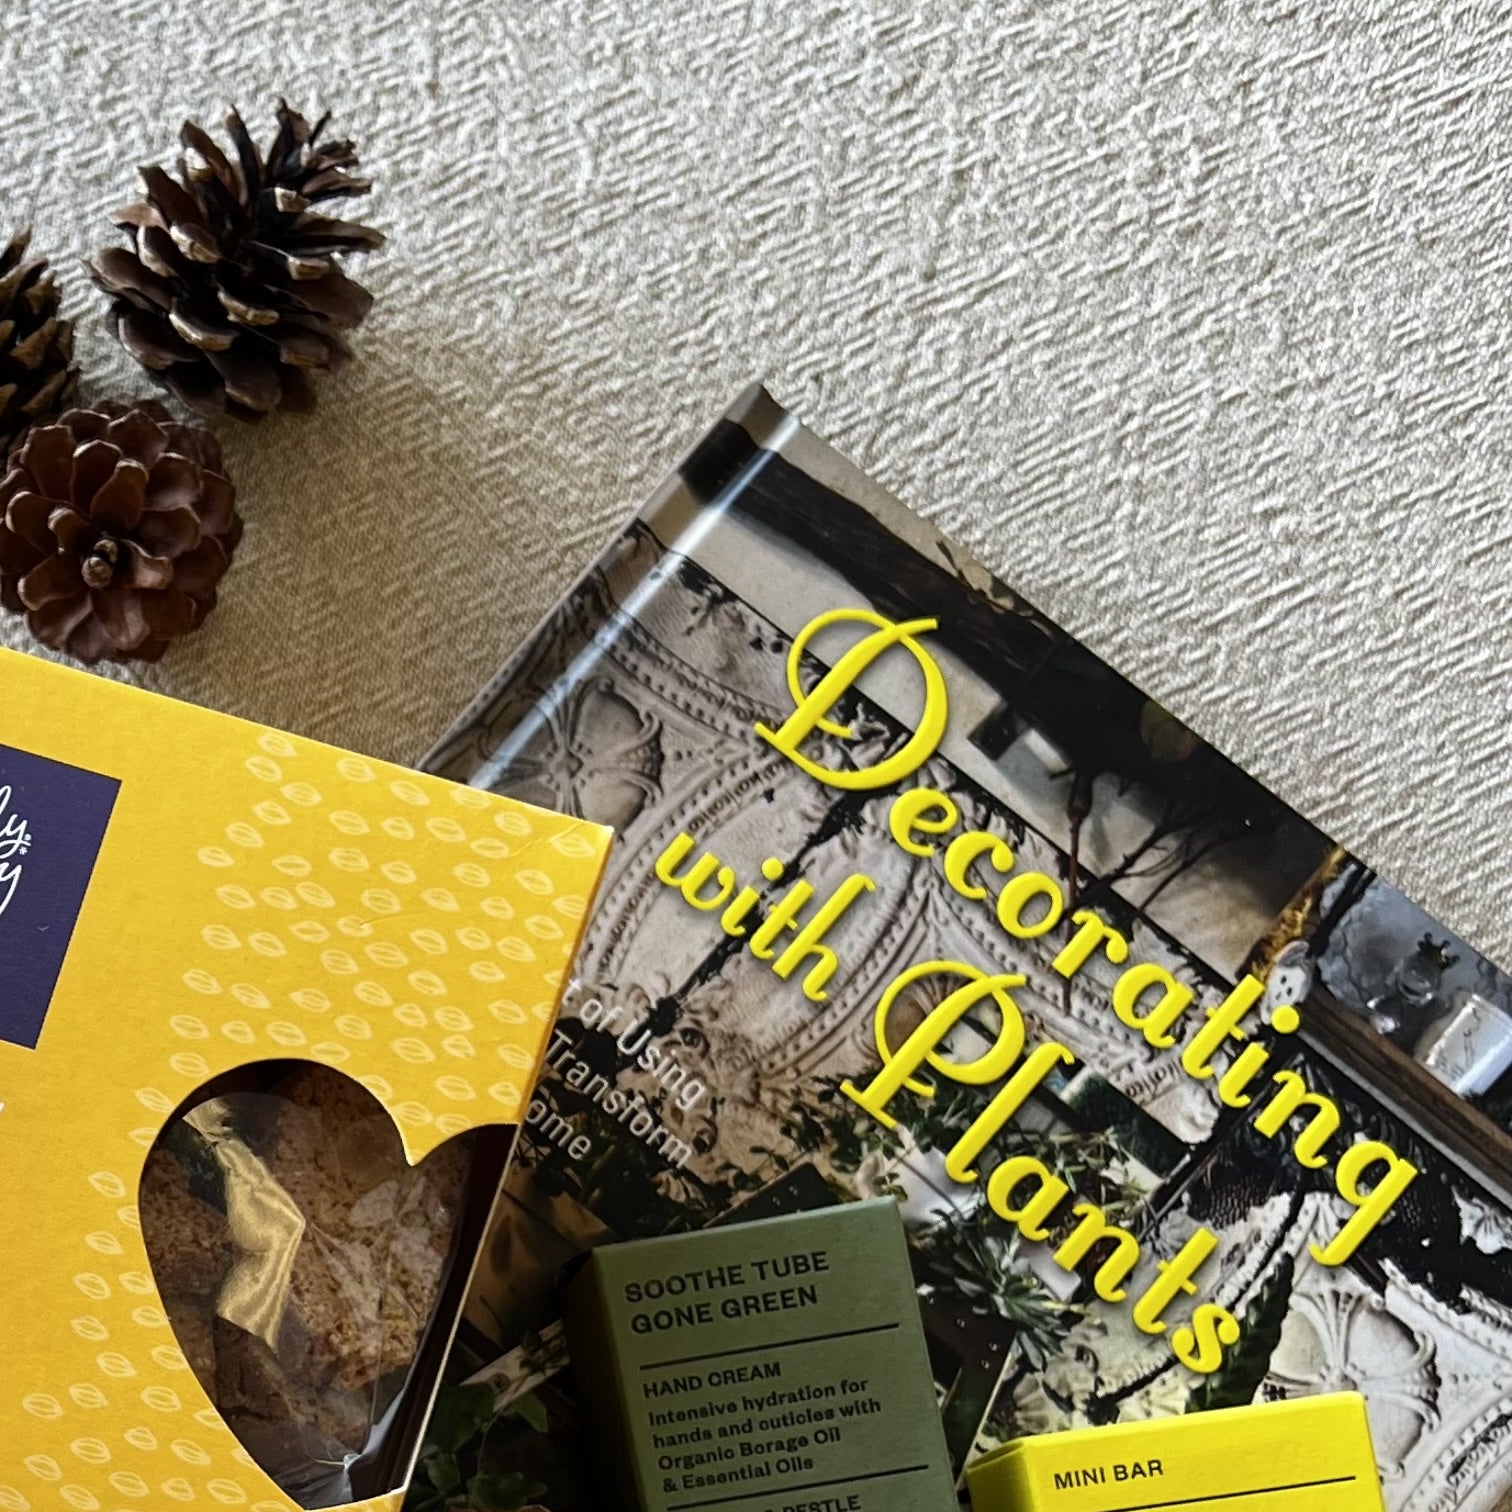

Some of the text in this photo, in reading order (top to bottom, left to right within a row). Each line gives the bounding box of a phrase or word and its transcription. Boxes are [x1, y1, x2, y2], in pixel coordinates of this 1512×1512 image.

[755, 608, 1417, 1267] Decorating
[579, 998, 706, 1111] of Using
[544, 1029, 692, 1168] Transform
[654, 832, 1240, 1375] with Plants
[525, 1100, 591, 1160] ome
[624, 1251, 829, 1303] SOOTHE TUBE
[631, 1285, 818, 1334] GONE GREEN
[643, 1362, 781, 1399] HAND CREAM
[649, 1377, 869, 1427] Intensive hydration for
[653, 1397, 881, 1448] hands and cuticles with
[658, 1427, 841, 1471] Organic Borage Oil
[663, 1455, 814, 1492] & Essential Oils
[1054, 1459, 1164, 1491] MINI BAR
